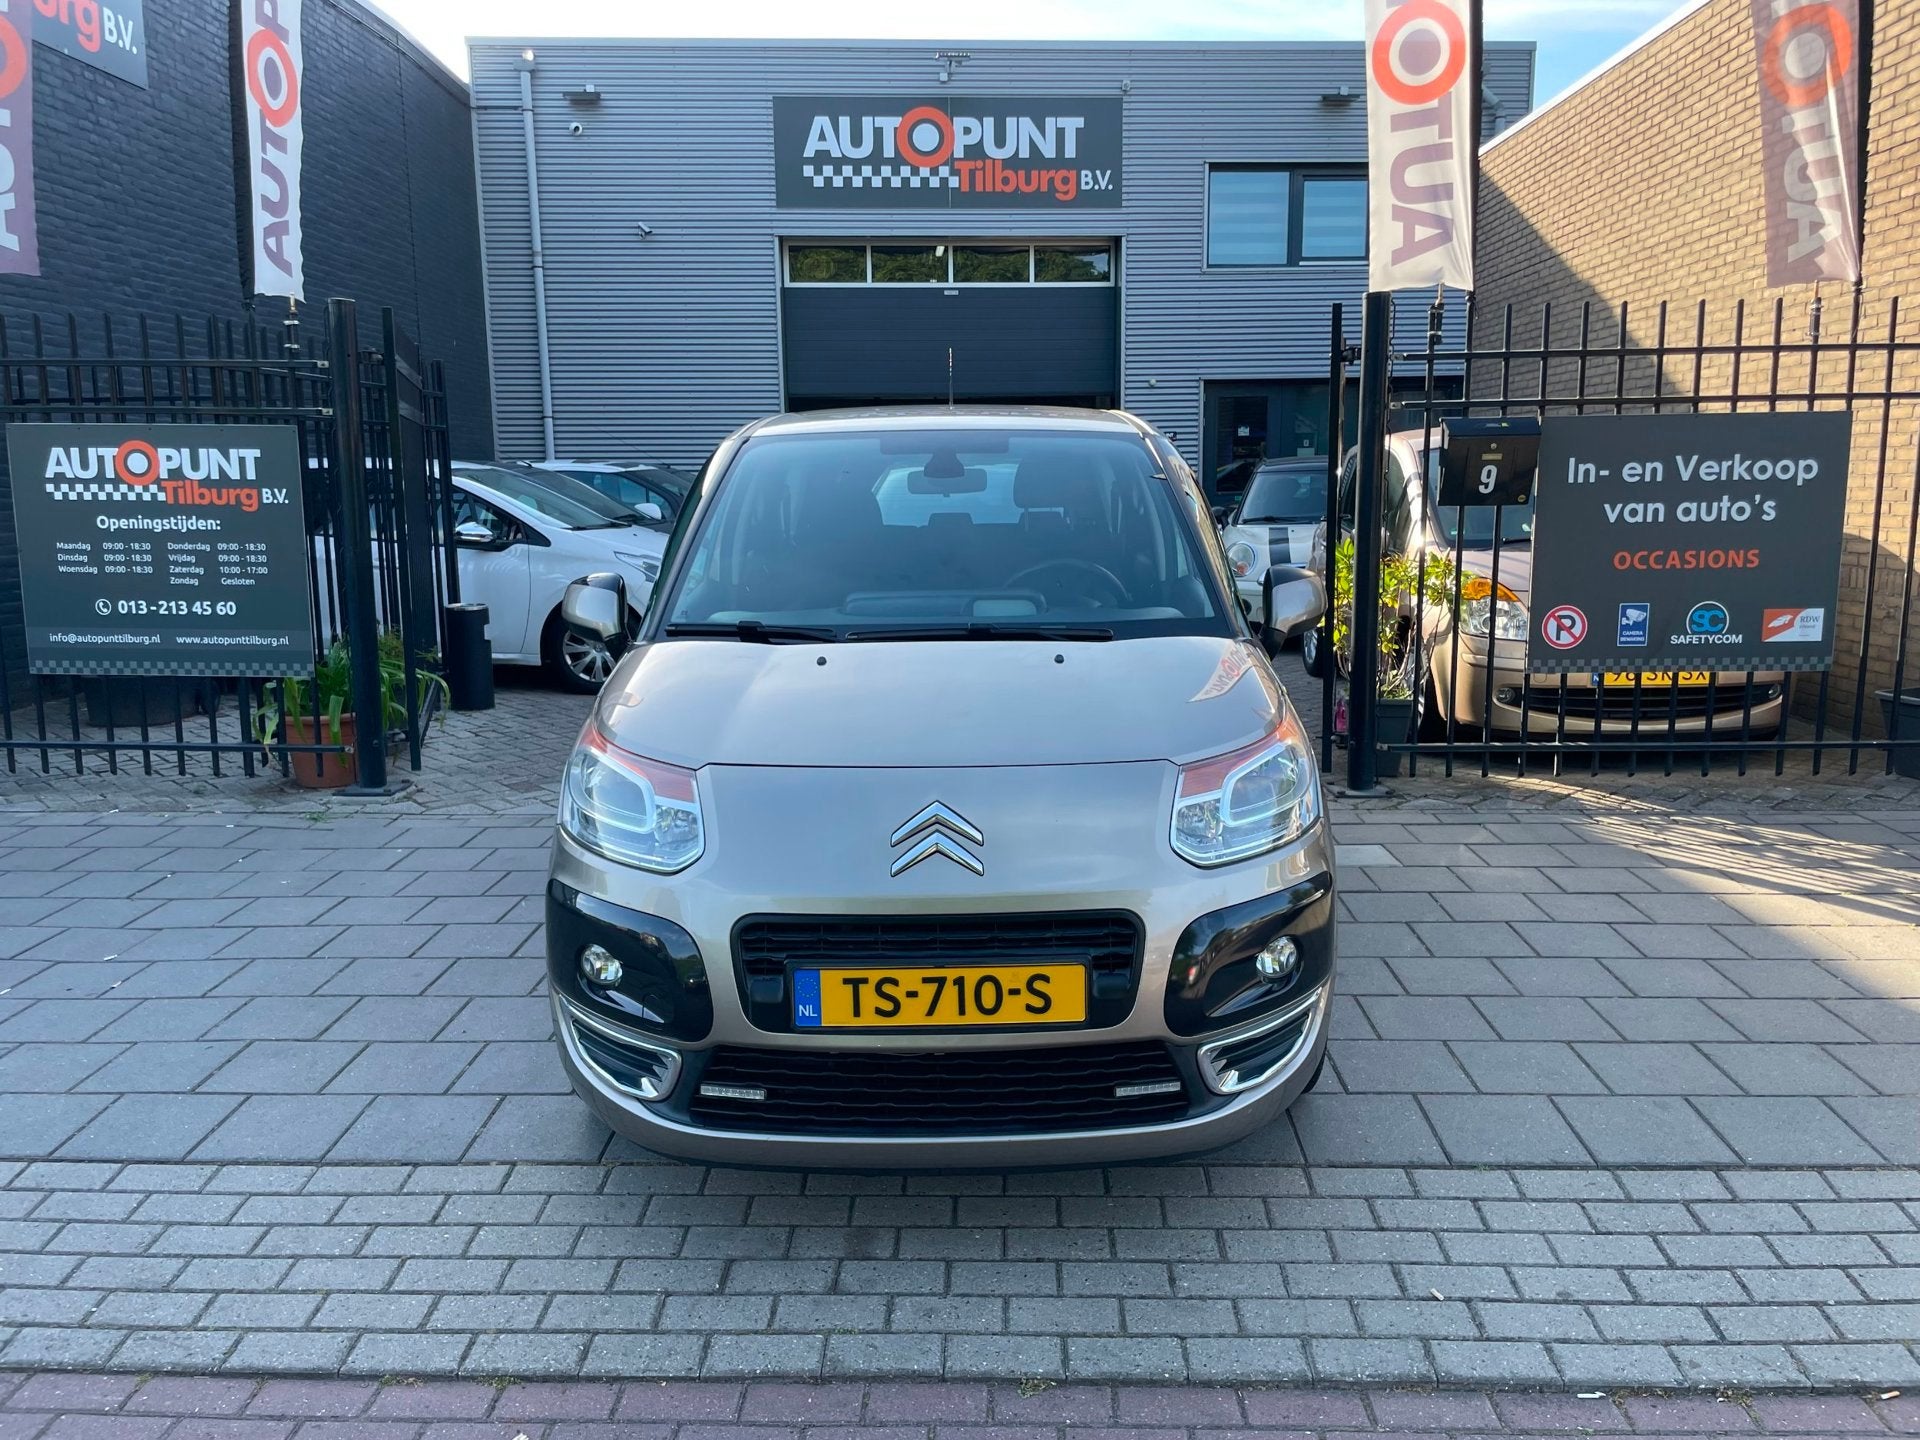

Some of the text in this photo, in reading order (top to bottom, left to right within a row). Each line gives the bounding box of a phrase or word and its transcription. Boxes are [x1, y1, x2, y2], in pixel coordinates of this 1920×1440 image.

[103, 7, 138, 54] B.V.
[803, 106, 1085, 169] AUTOPUNT
[954, 158, 1114, 201] Tilburg B.V.
[45, 440, 261, 486] AUTOPUNT
[1567, 454, 1819, 486] In- en Verkoop
[1478, 465, 1498, 494] 9
[161, 479, 289, 512] Tilburg B.V.
[1604, 502, 1665, 523] van
[96, 514, 221, 533] Openingstijden:
[56, 541, 91, 551] Maandag
[167, 542, 211, 551] Donderdag
[217, 543, 239, 551] 09:00
[246, 543, 266, 551] 18:30
[57, 553, 88, 562] Dinsdag
[104, 554, 125, 562] 09:00
[132, 554, 152, 562] 18:30
[168, 554, 196, 563] Vrijdag
[246, 555, 267, 563] 18:30
[1613, 549, 1760, 570] OCCASIONS
[58, 565, 98, 575] Woensdag
[132, 566, 153, 574] 18:30
[169, 566, 205, 575] Zaterdag
[220, 566, 241, 574] 10:00
[170, 577, 256, 586] Zondag Gesloten
[192, 601, 212, 615] 45
[216, 601, 236, 615] 60
[49, 633, 289, 647] info@autopunttilburg.nl www.autopunttilburg.nl
[1670, 634, 1743, 644] SAFETYCOM
[842, 973, 1052, 1018] TS-710-S
[799, 1005, 817, 1017] NL
